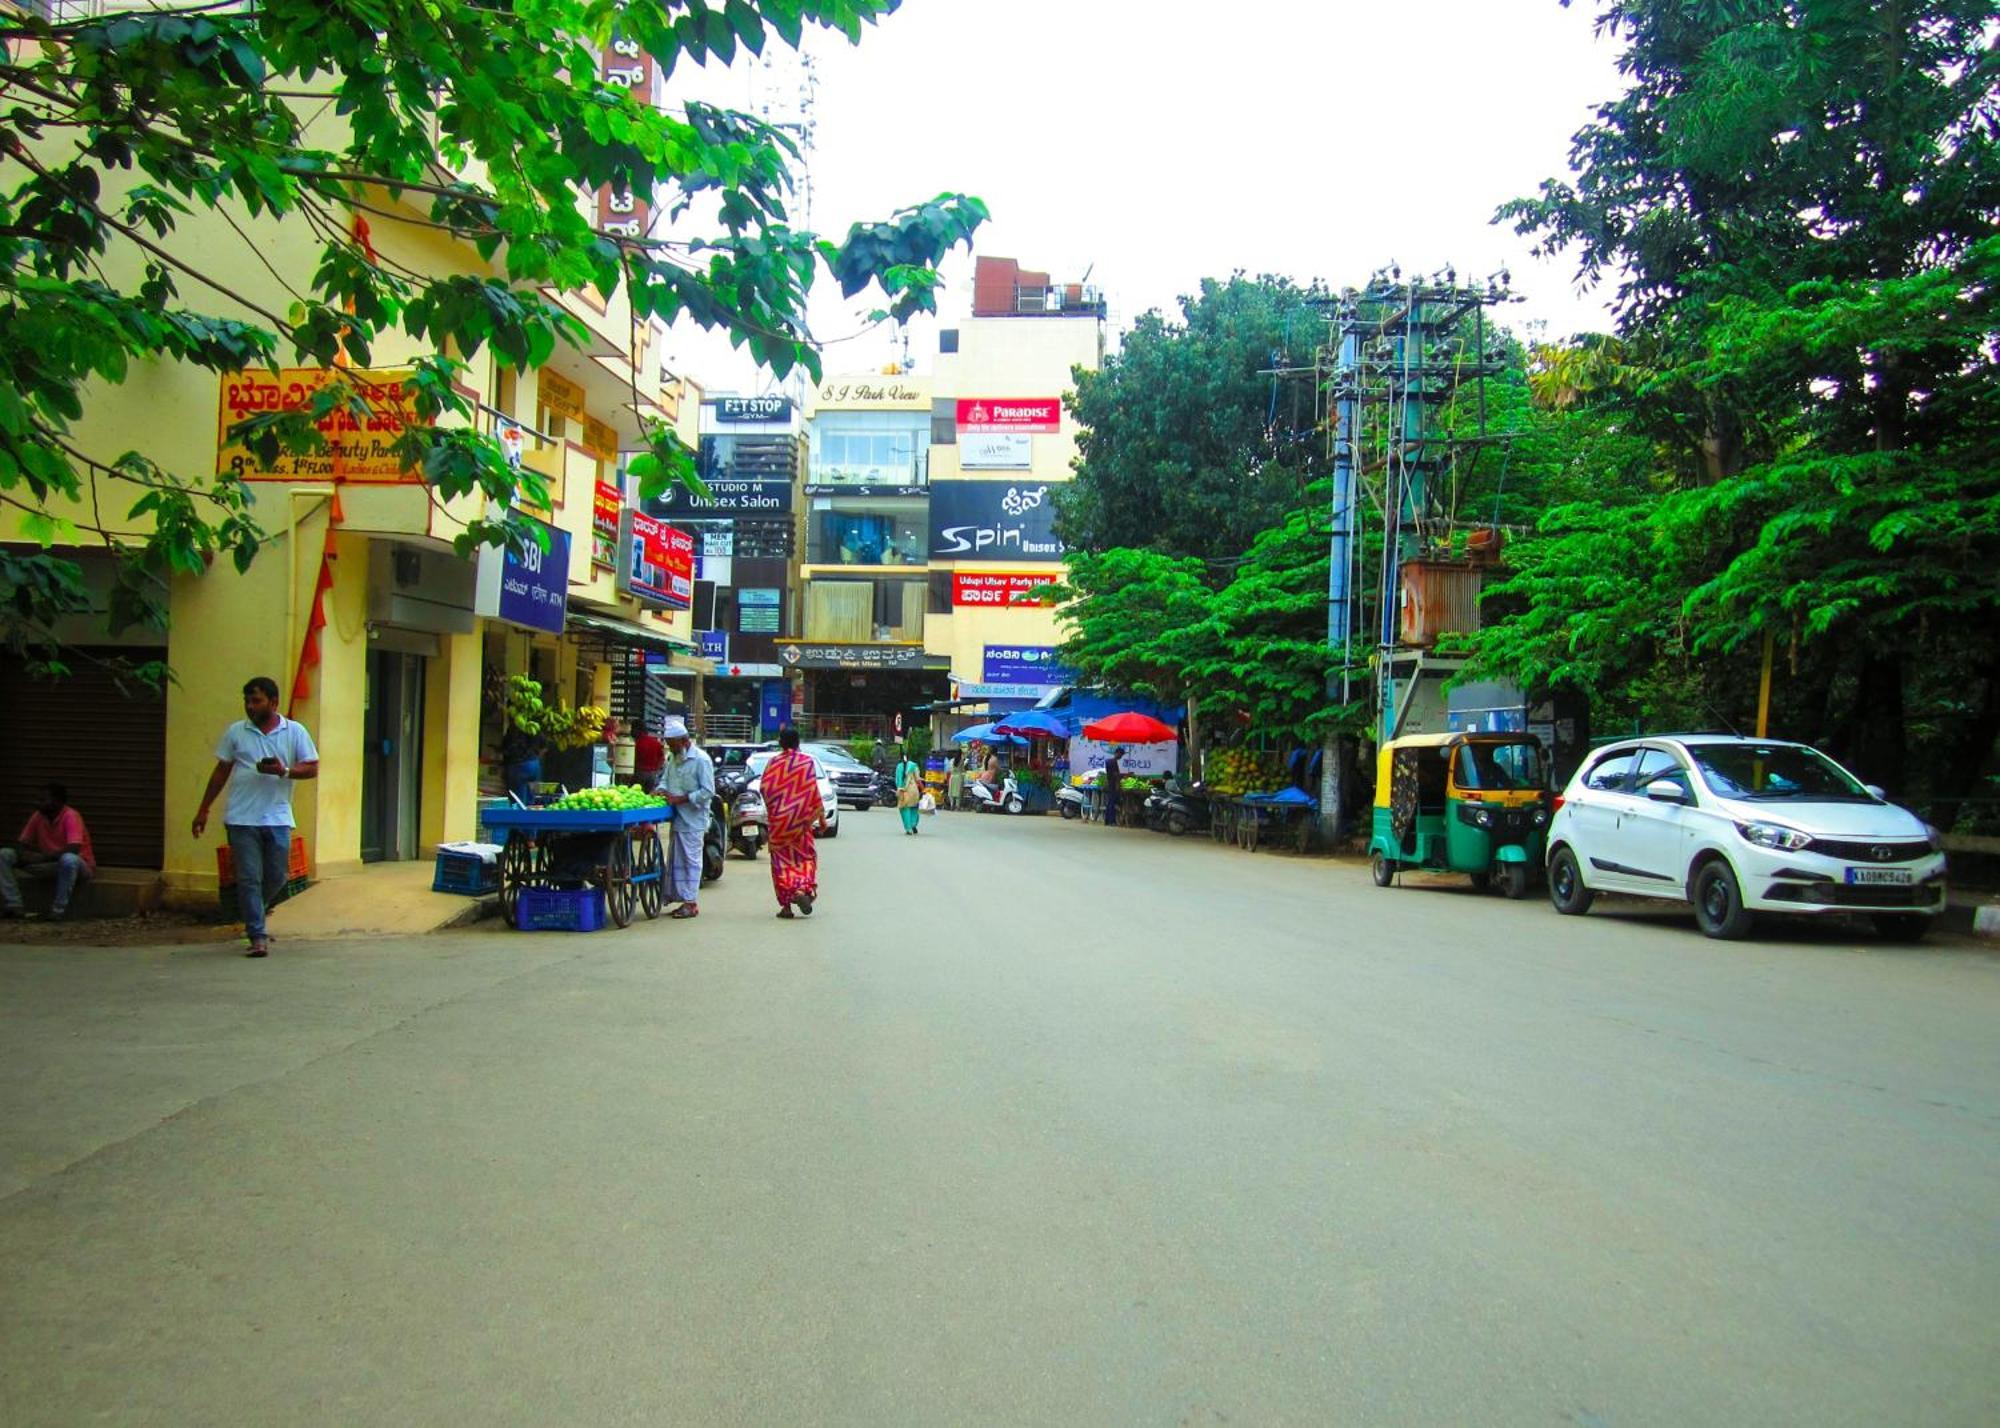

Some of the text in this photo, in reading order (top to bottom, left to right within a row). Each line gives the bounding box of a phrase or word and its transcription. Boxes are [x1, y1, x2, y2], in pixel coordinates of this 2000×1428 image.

[750, 399, 782, 412] STOP
[707, 483, 763, 492] STUDIO M
[739, 494, 780, 508] Salon
[522, 538, 542, 574] SBI
[1010, 578, 1032, 587] Party
